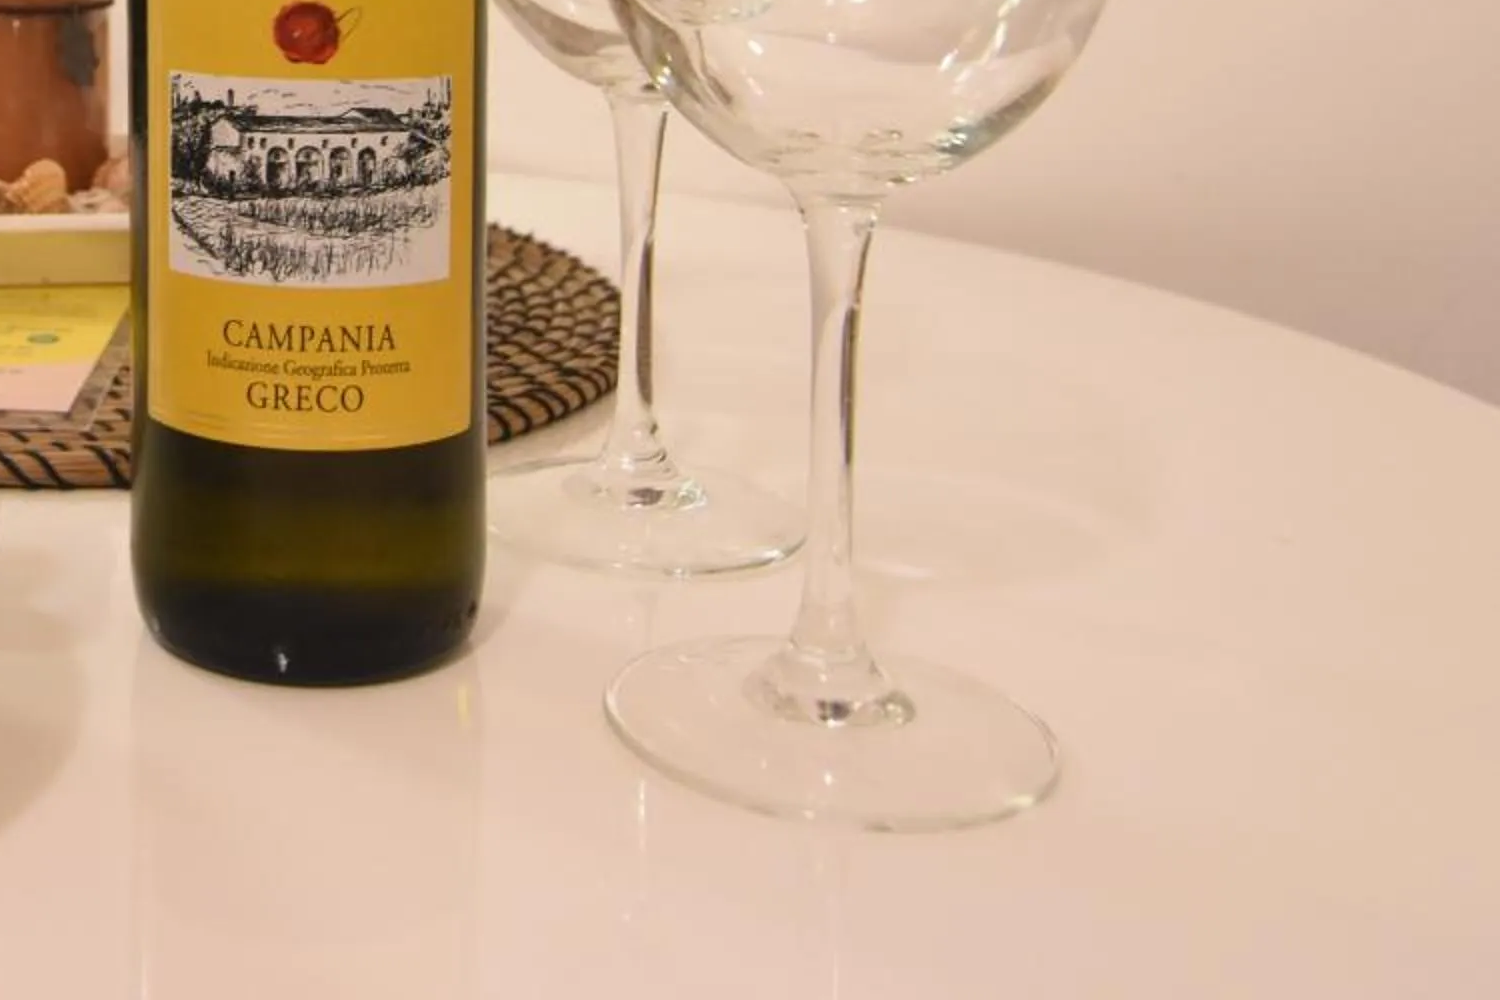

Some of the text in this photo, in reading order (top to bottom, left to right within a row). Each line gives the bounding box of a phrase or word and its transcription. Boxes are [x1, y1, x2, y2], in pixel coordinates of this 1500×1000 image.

[222, 320, 397, 353] CAMPANIA
[206, 351, 280, 377] Indicazione
[283, 360, 358, 381] Geografica
[245, 381, 365, 413] GRECO
